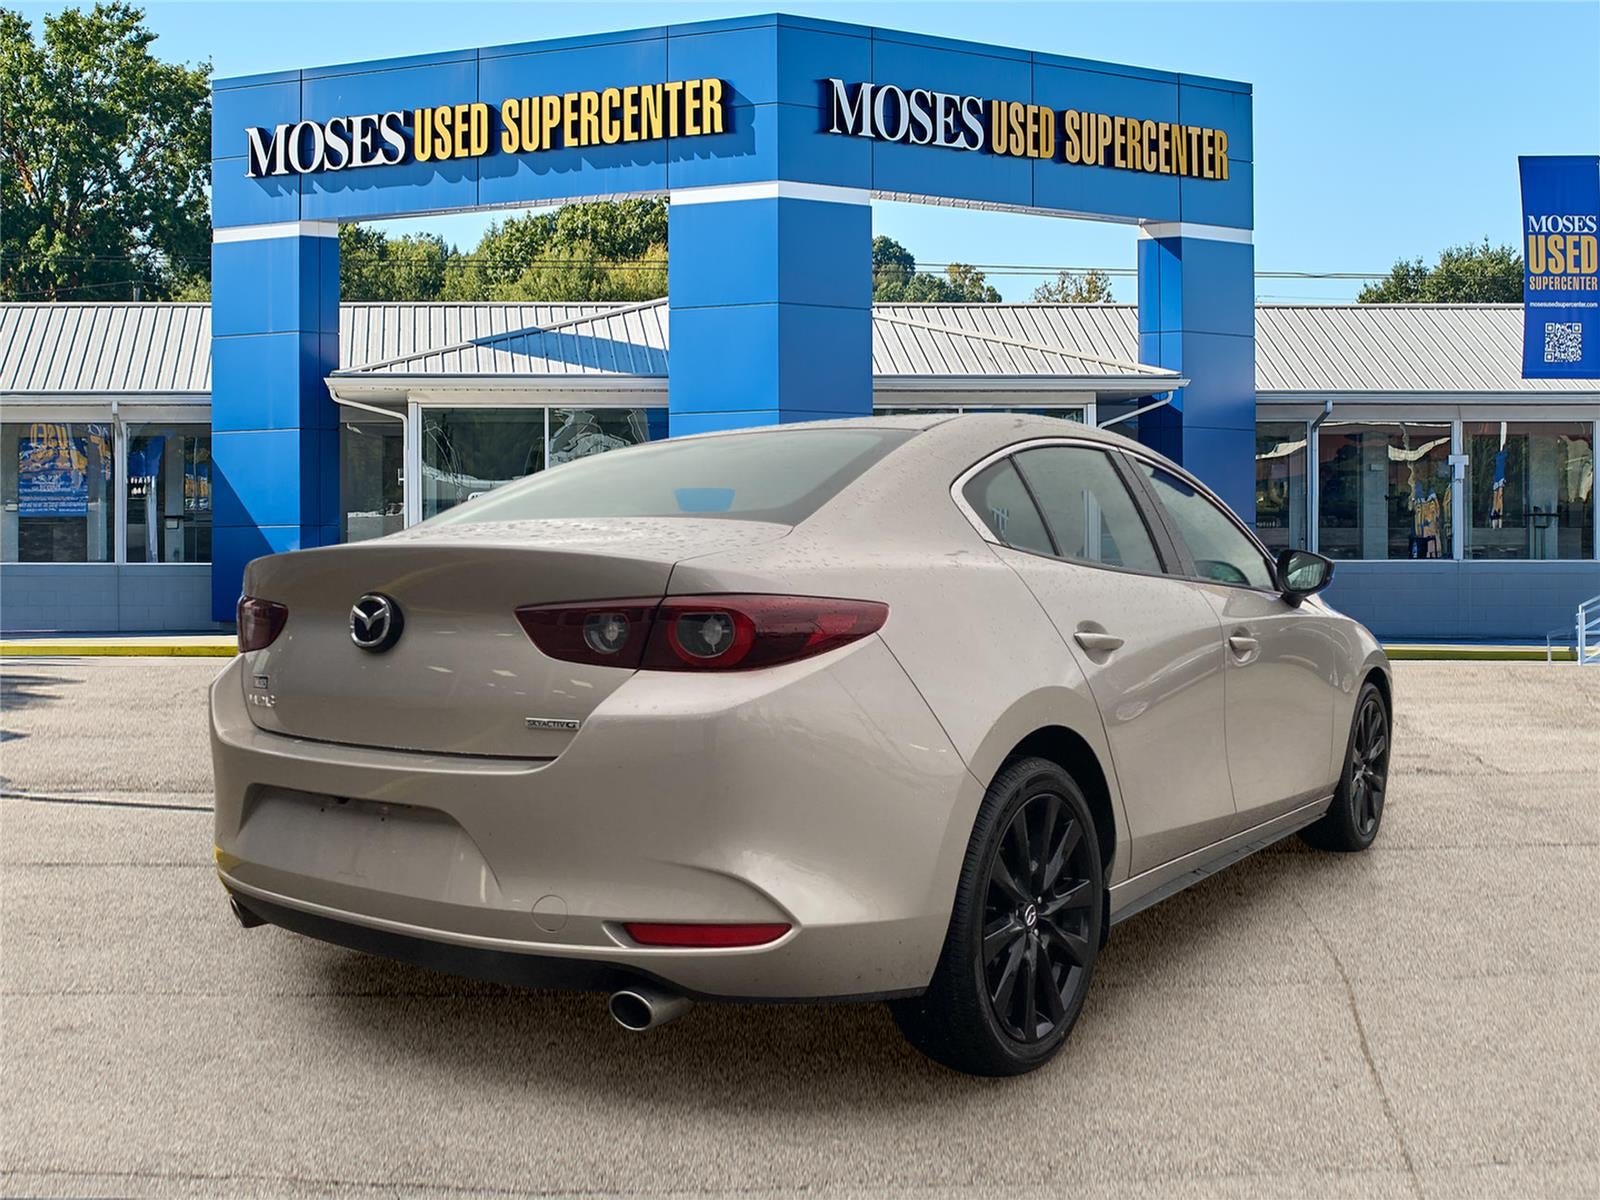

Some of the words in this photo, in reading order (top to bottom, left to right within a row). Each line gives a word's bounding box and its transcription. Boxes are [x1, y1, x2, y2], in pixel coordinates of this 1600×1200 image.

[244, 111, 407, 178] MOSES
[413, 103, 489, 162] USED
[500, 77, 725, 154] SUPERCENTER
[829, 78, 985, 151] MOSES
[991, 100, 1056, 159] USED
[1064, 109, 1230, 181] SUPERCENTER
[1528, 215, 1597, 233] MOSES
[1528, 235, 1598, 274] USED
[1529, 276, 1598, 291] SUPERCENTER
